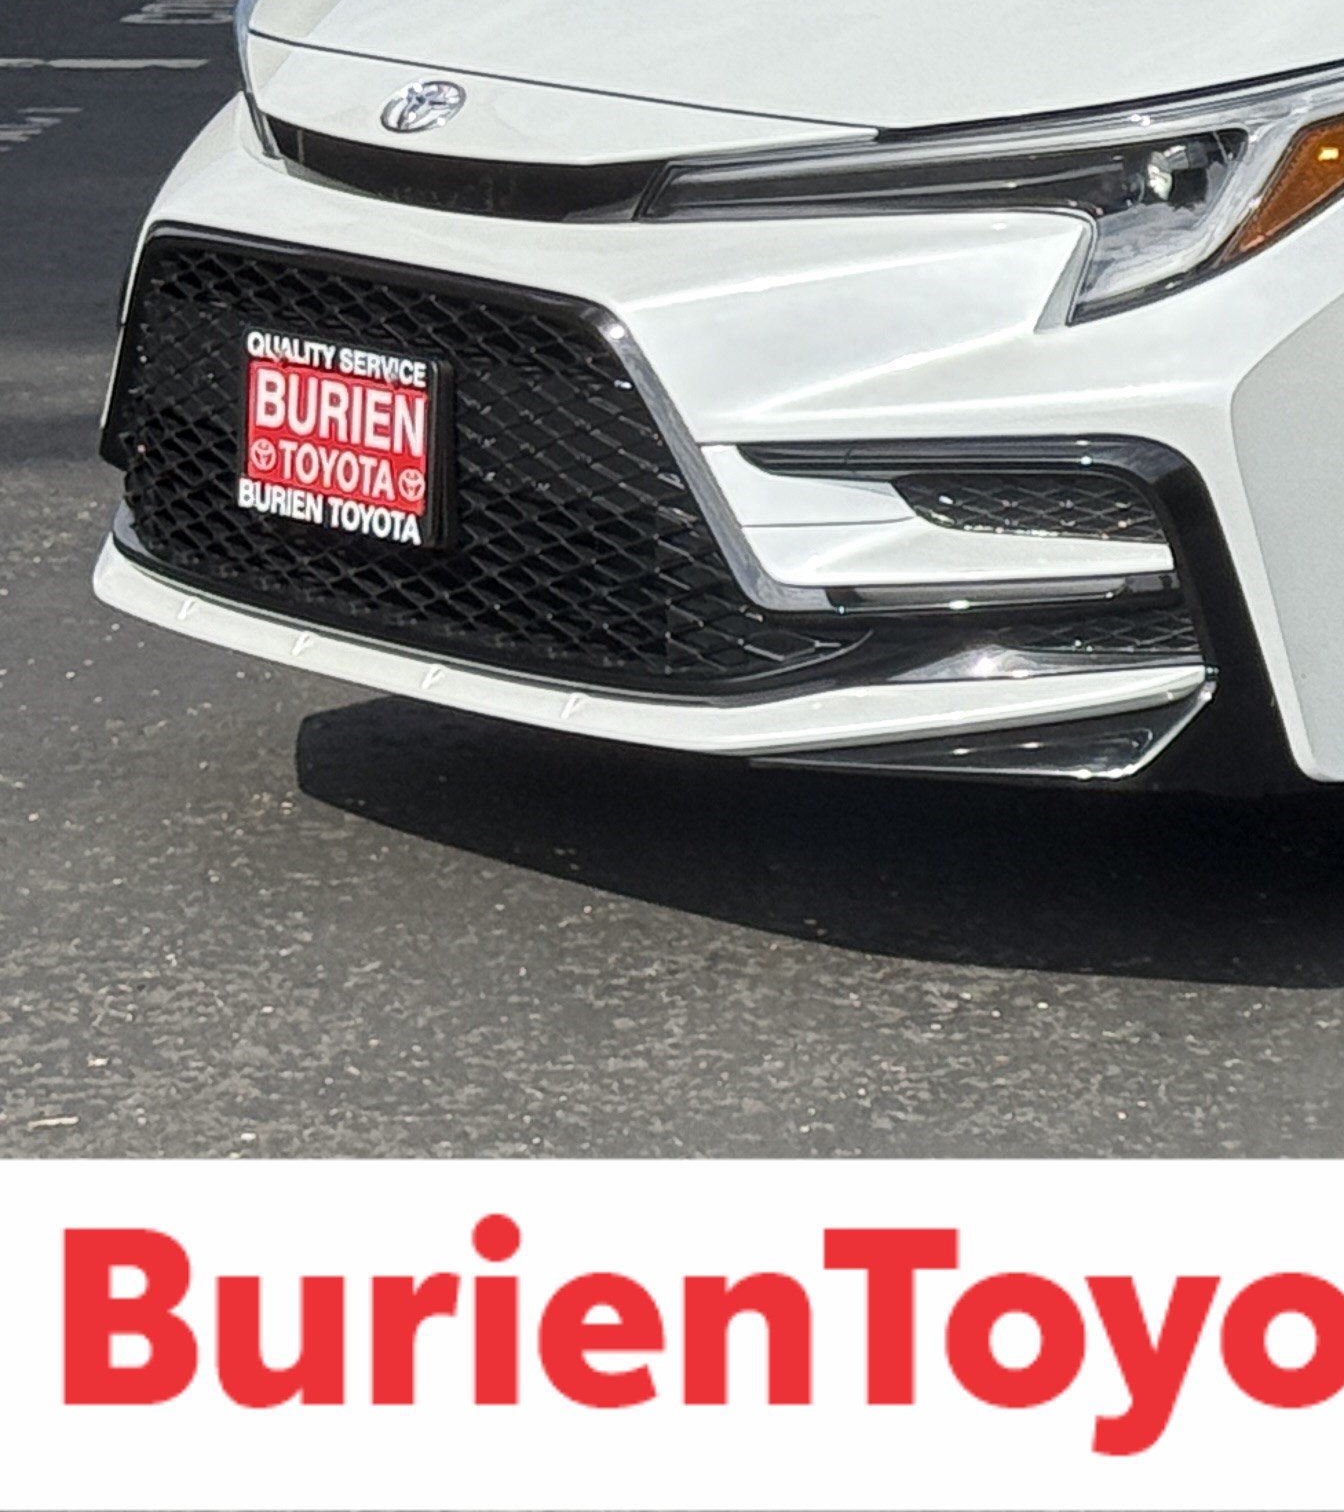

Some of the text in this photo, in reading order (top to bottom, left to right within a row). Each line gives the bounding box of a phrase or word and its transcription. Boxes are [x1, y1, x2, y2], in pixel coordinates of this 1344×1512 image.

[247, 331, 427, 388] QUALITY SERVICE
[255, 368, 426, 458] BURIEN
[278, 439, 396, 501] TOYOTA
[237, 477, 422, 546] BURIEN TOYOTA
